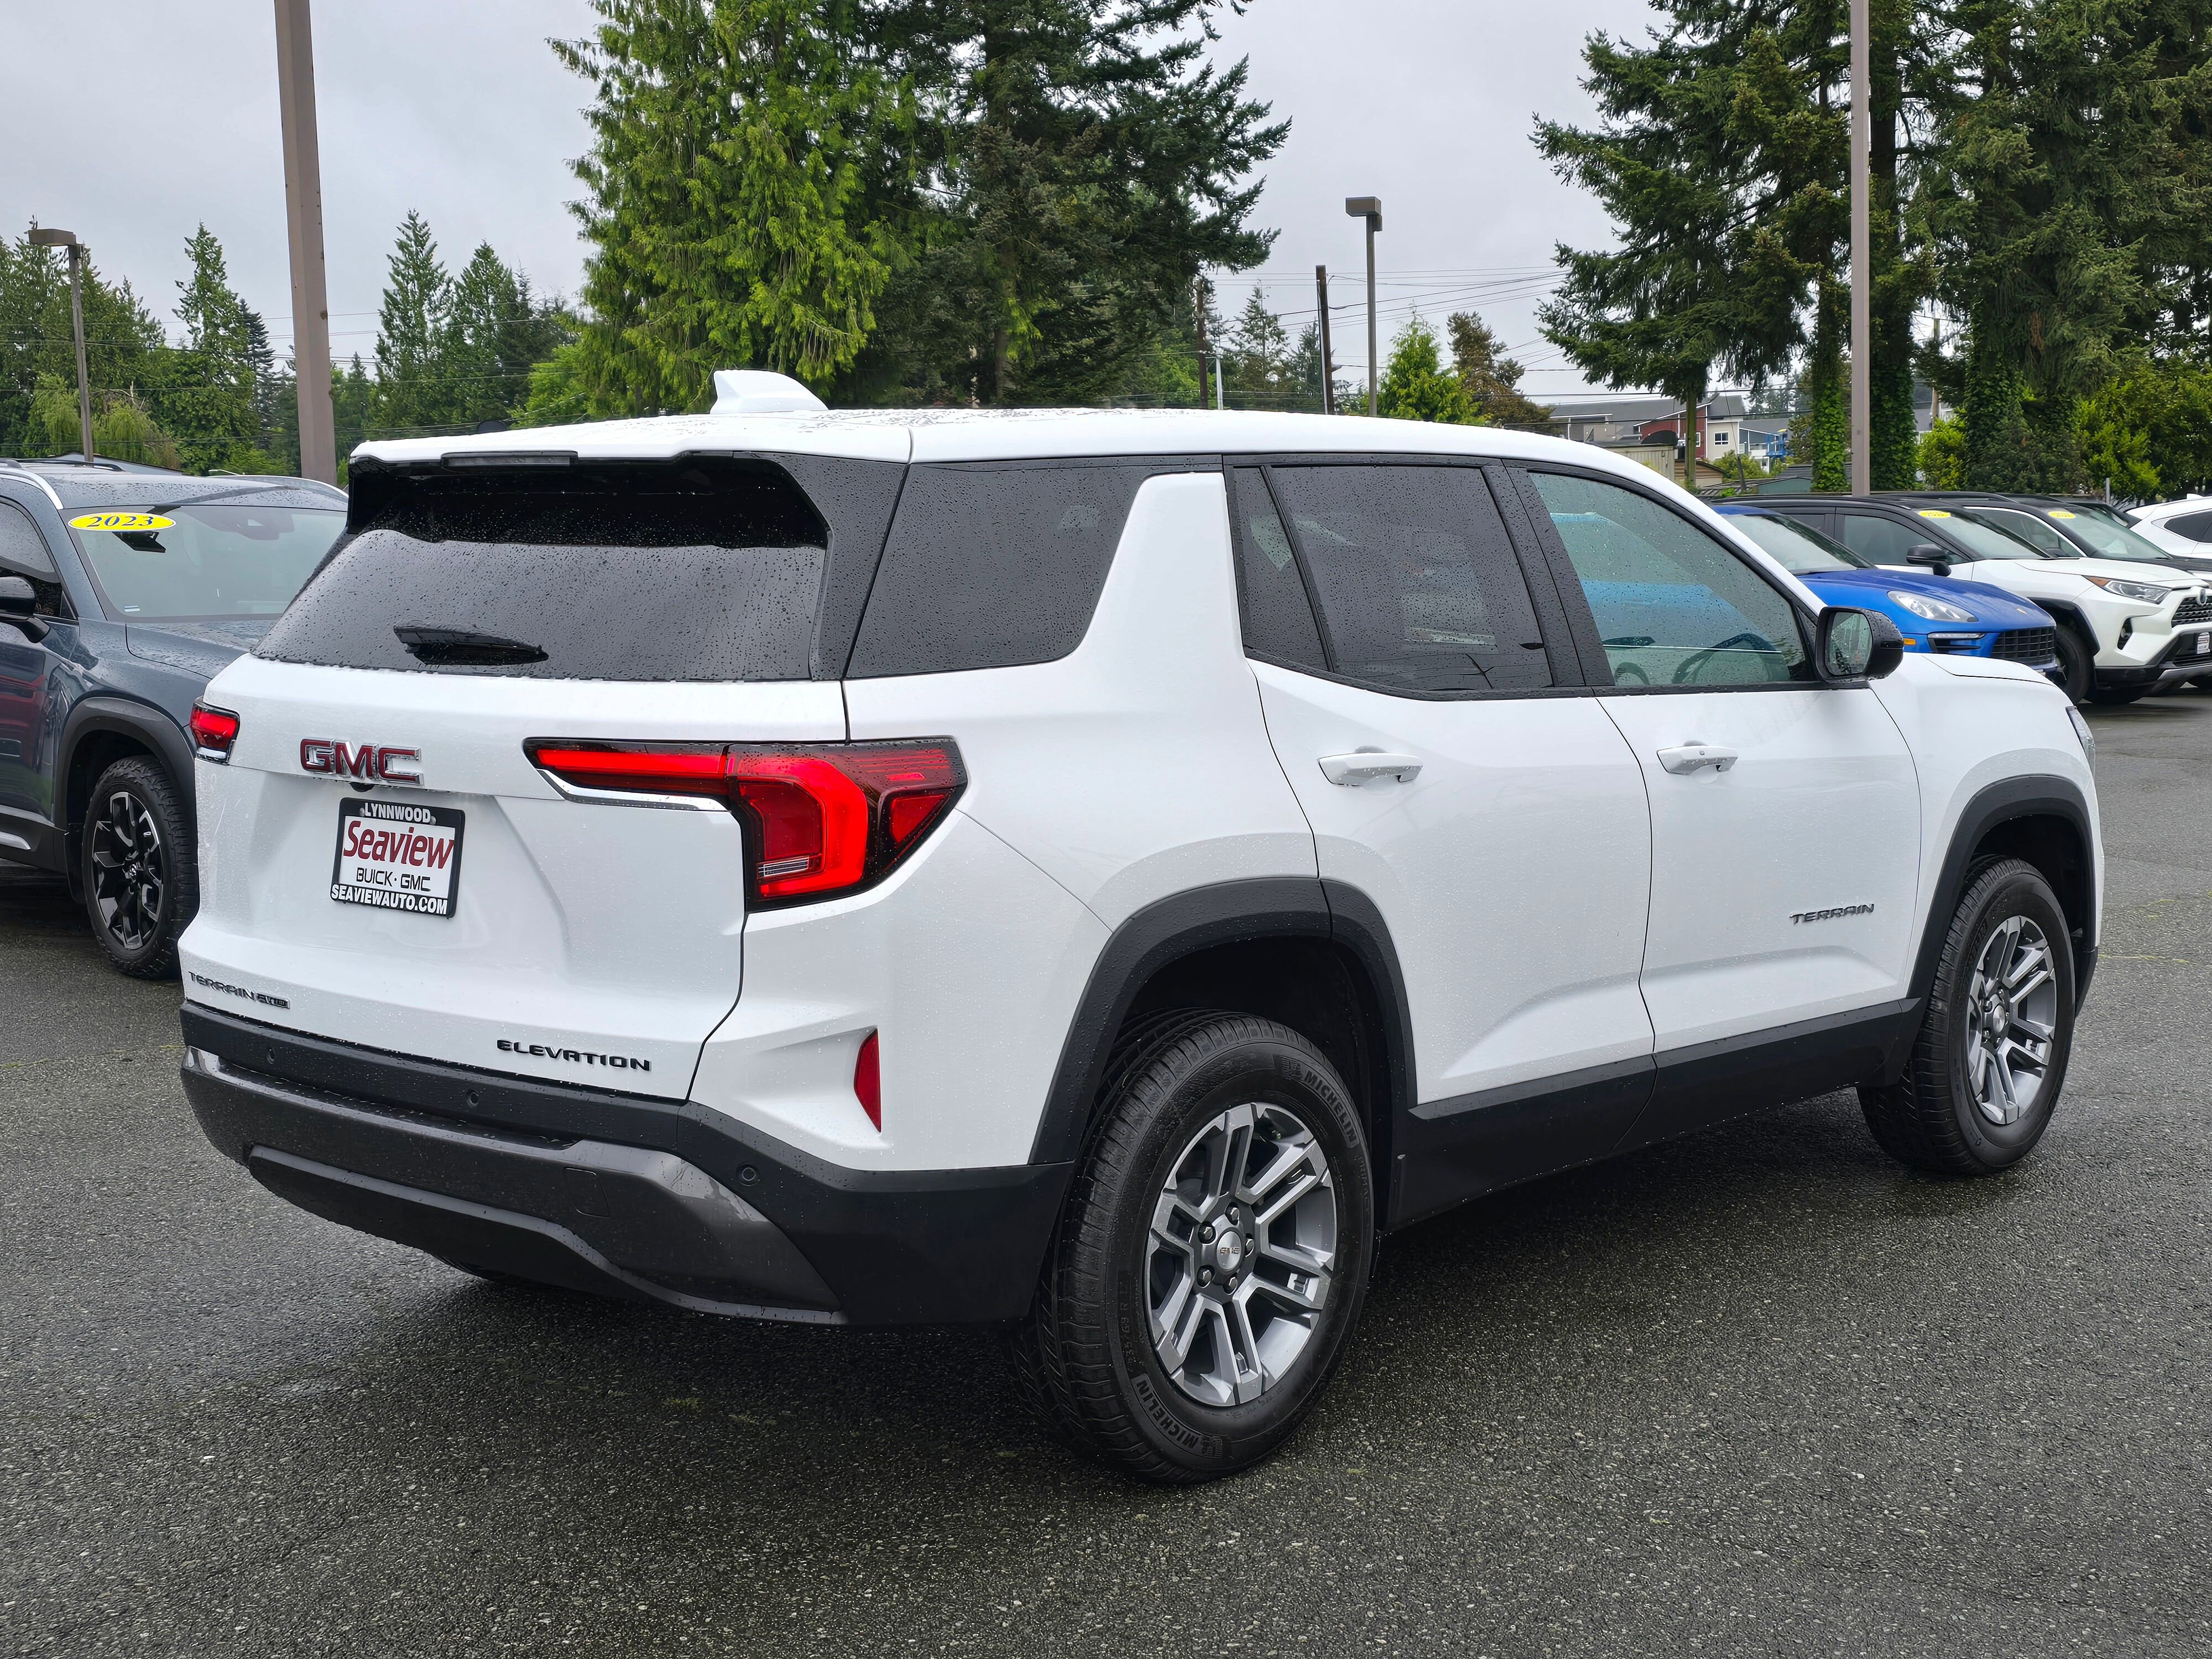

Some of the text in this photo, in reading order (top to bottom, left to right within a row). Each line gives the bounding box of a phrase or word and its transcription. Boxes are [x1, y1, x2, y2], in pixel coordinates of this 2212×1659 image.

[86, 515, 154, 528] 2023
[300, 737, 425, 785] GMC
[364, 802, 431, 823] LYNNWOOD
[343, 820, 455, 869] Seaview
[356, 868, 431, 892] BUICK GMC
[331, 884, 448, 915] SEAVIEWAUTO.COM
[1789, 903, 1875, 925] TERRAIN
[188, 971, 257, 1002] TERRAIN
[497, 1040, 651, 1072] ELEVATION
[1304, 1070, 1357, 1142] MICHELIN
[1136, 1380, 1199, 1449] MICHELIN
